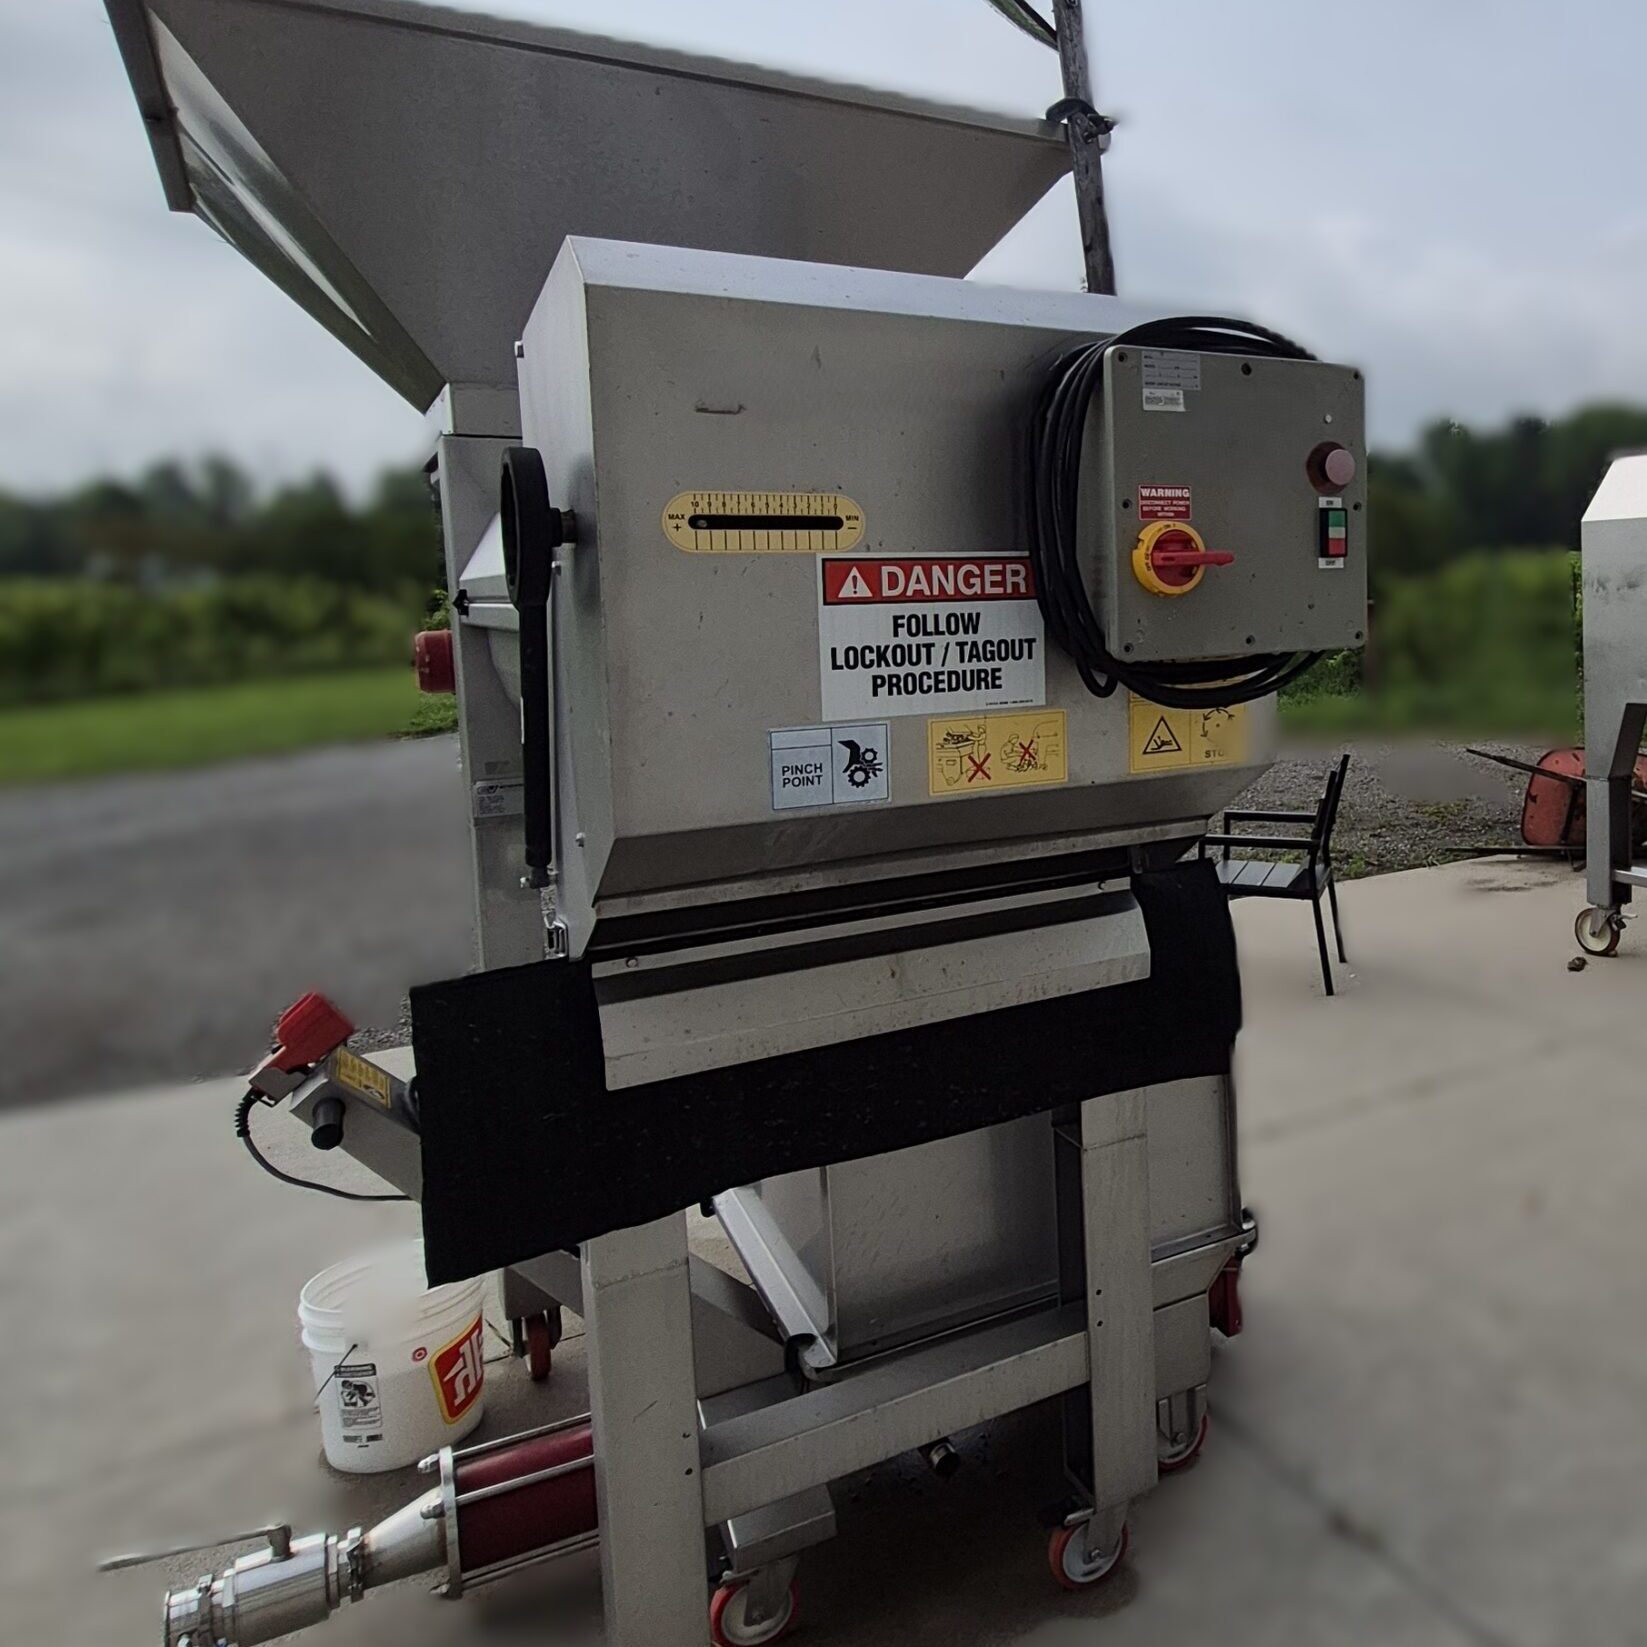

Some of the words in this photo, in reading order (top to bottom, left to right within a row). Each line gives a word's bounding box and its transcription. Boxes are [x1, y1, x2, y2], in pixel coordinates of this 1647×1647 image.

[1141, 488, 1190, 498] WARNING
[880, 563, 1027, 597] DANGER
[892, 612, 981, 638] FOLLOW
[830, 642, 935, 670] LOCKOUT
[941, 642, 950, 667] /
[955, 638, 1037, 663] TAGOUT
[871, 668, 1003, 697] PROCEDURE
[1204, 749, 1225, 758] STO
[781, 763, 823, 776] PINCH
[782, 775, 823, 788] POINT
